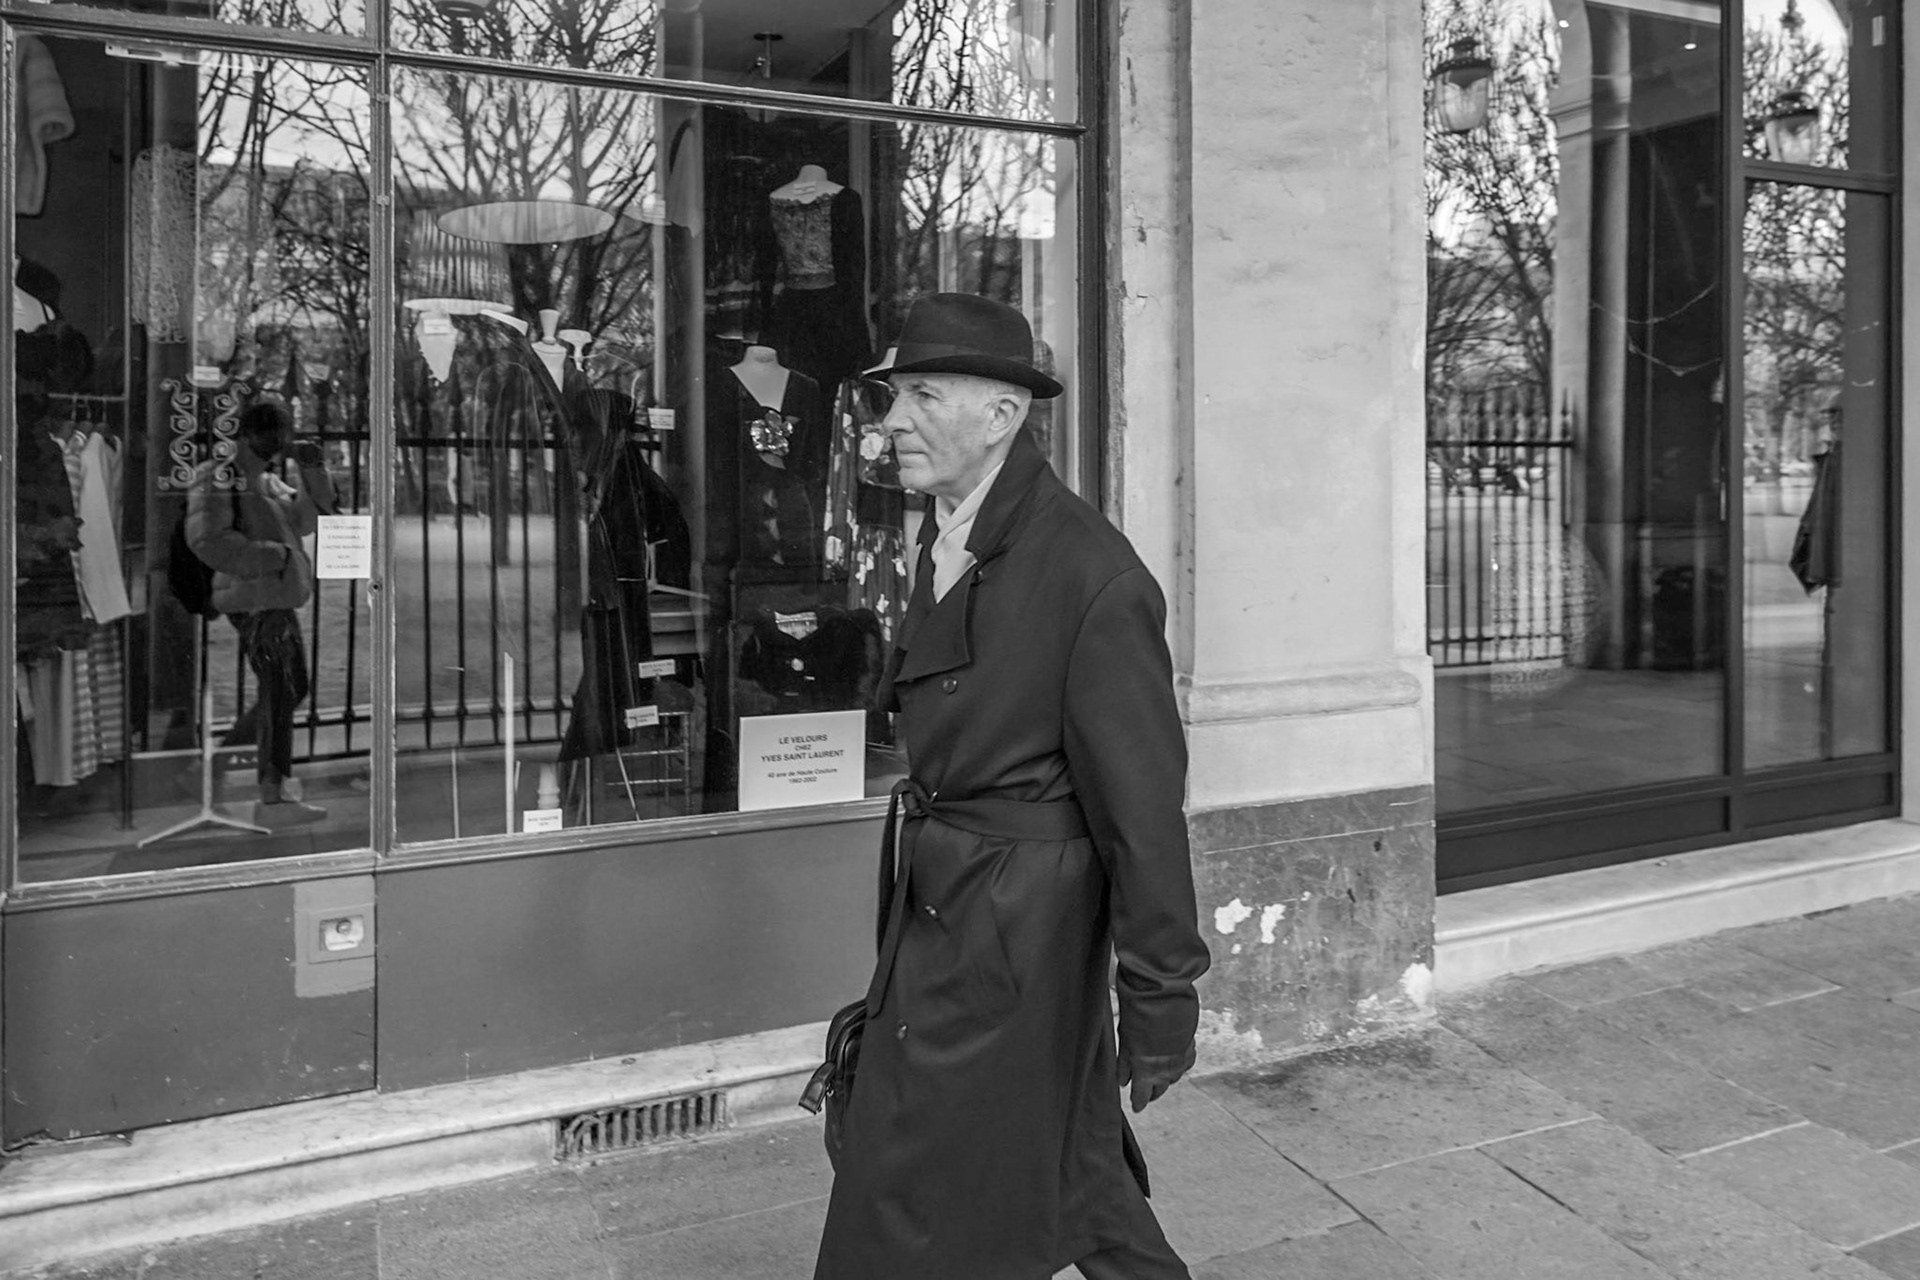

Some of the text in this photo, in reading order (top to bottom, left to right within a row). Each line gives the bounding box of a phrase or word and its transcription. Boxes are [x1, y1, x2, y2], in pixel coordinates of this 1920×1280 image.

[779, 734, 828, 744] LE VELOURS
[761, 749, 844, 762] YVES SAINT LAURENT
